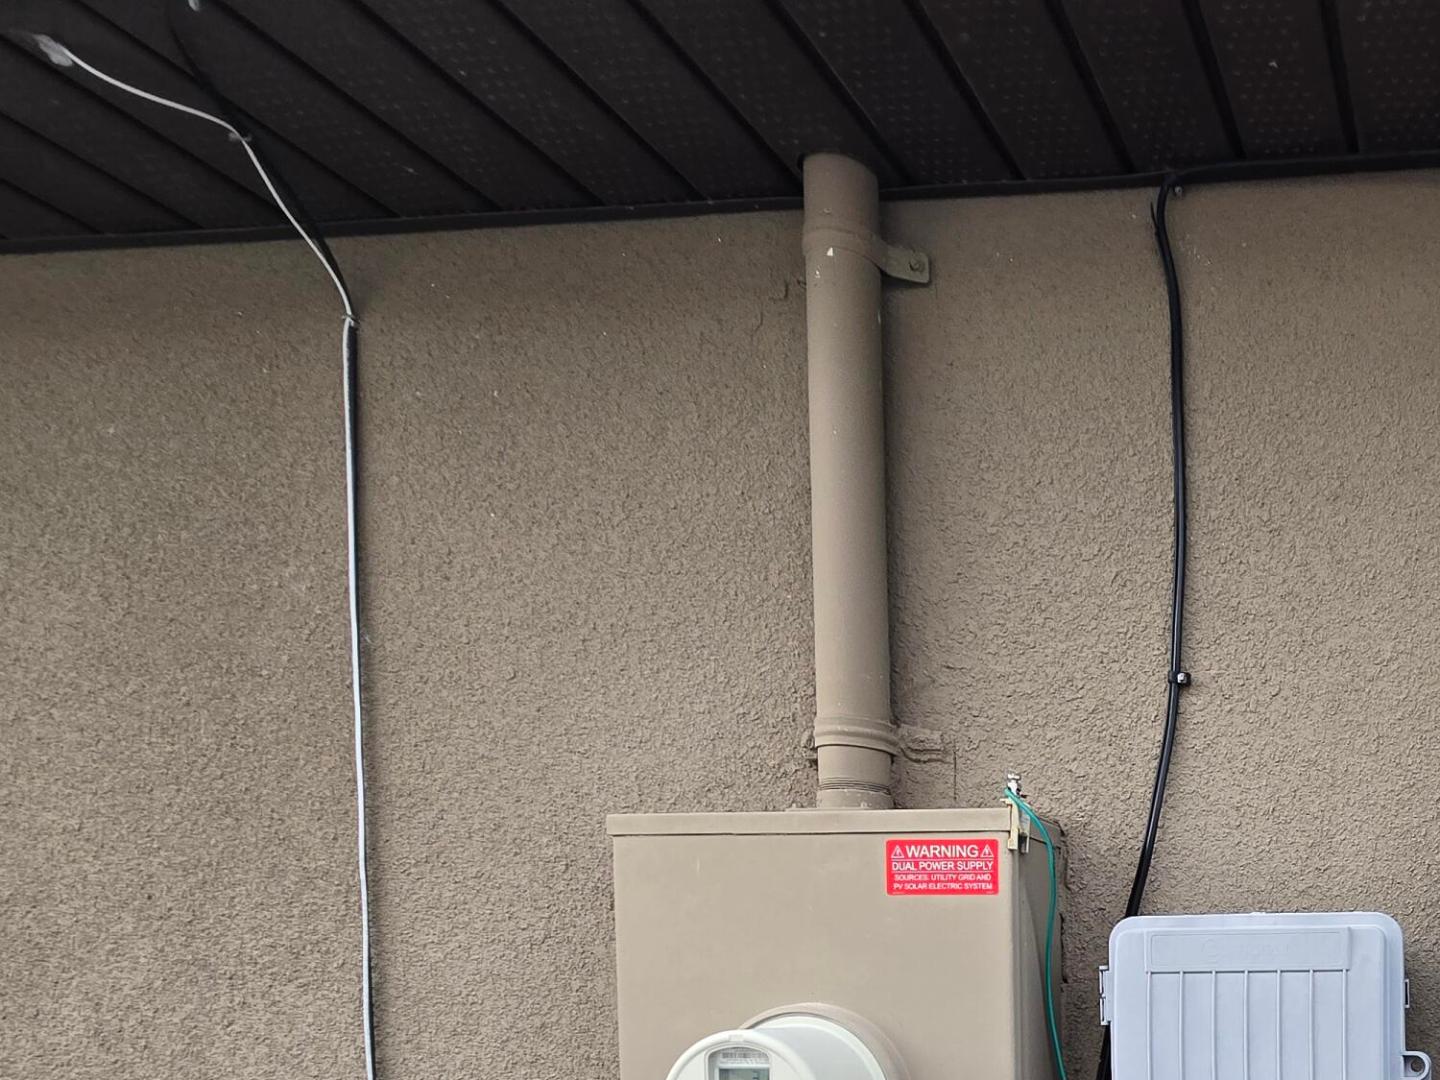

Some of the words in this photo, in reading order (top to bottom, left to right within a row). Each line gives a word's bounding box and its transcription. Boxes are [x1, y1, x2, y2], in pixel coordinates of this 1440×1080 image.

[905, 844, 979, 858] WARNING
[891, 861, 917, 871] DUAL
[919, 861, 954, 871] POWER
[956, 861, 994, 871] SUPPLY
[931, 873, 957, 881] UTILITY
[958, 873, 976, 881] GRID
[976, 873, 992, 881] AND
[893, 882, 903, 890] PV
[904, 882, 928, 890] SOLAR
[928, 882, 962, 890] ELECTRIC
[964, 882, 993, 890] SYSTEM
